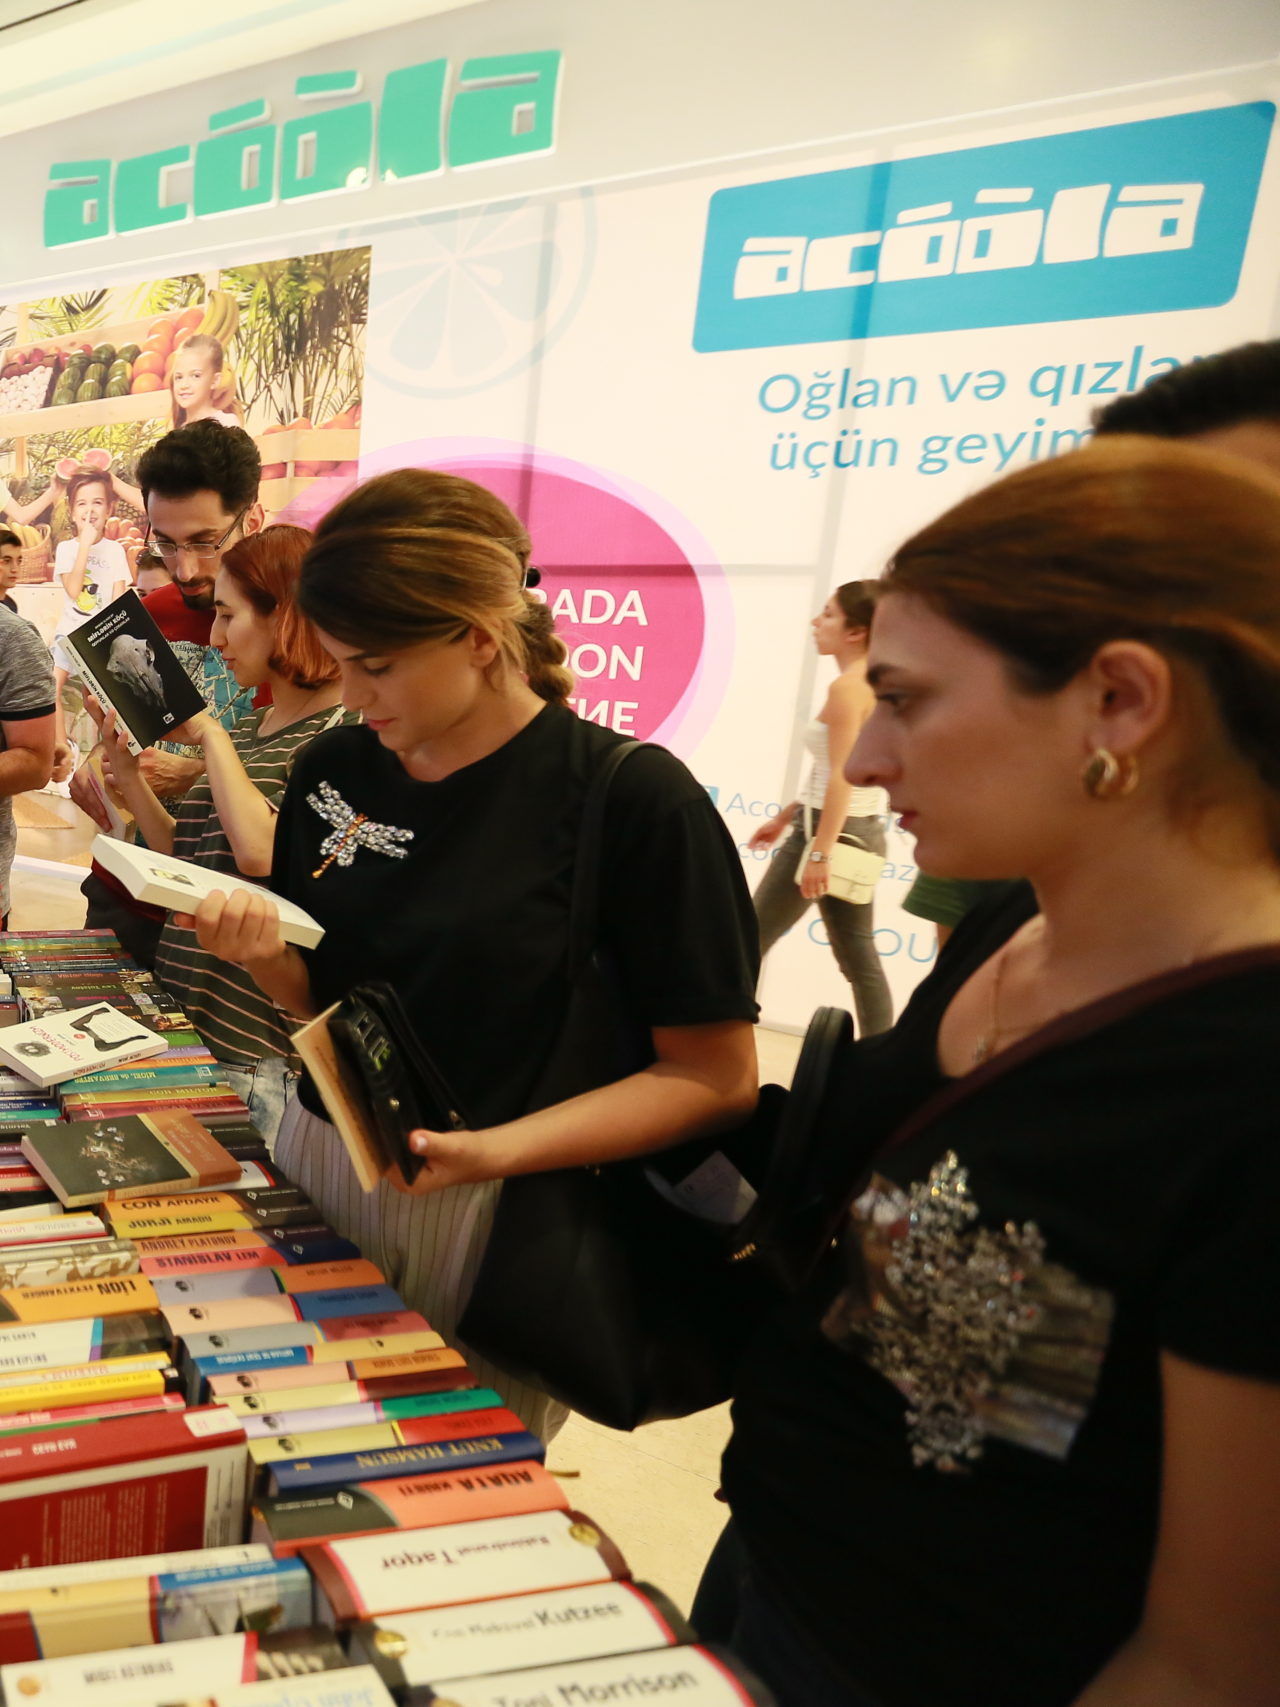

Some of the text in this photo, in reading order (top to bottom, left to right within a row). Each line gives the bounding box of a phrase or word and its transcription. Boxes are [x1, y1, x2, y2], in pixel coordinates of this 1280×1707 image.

[757, 367, 917, 421] Oğlan
[939, 369, 1006, 404] və
[769, 429, 899, 479] üçün
[121, 1199, 161, 1211] CON
[140, 1235, 238, 1252] ANDREY PLATONOV
[236, 1249, 260, 1261] LEM
[355, 1437, 504, 1469] KNUT HAMSUN
[457, 1467, 536, 1492] AQATA
[381, 1548, 455, 1570] Taqor
[535, 1601, 624, 1628] Kutzee
[554, 1670, 700, 1705] Morrison
